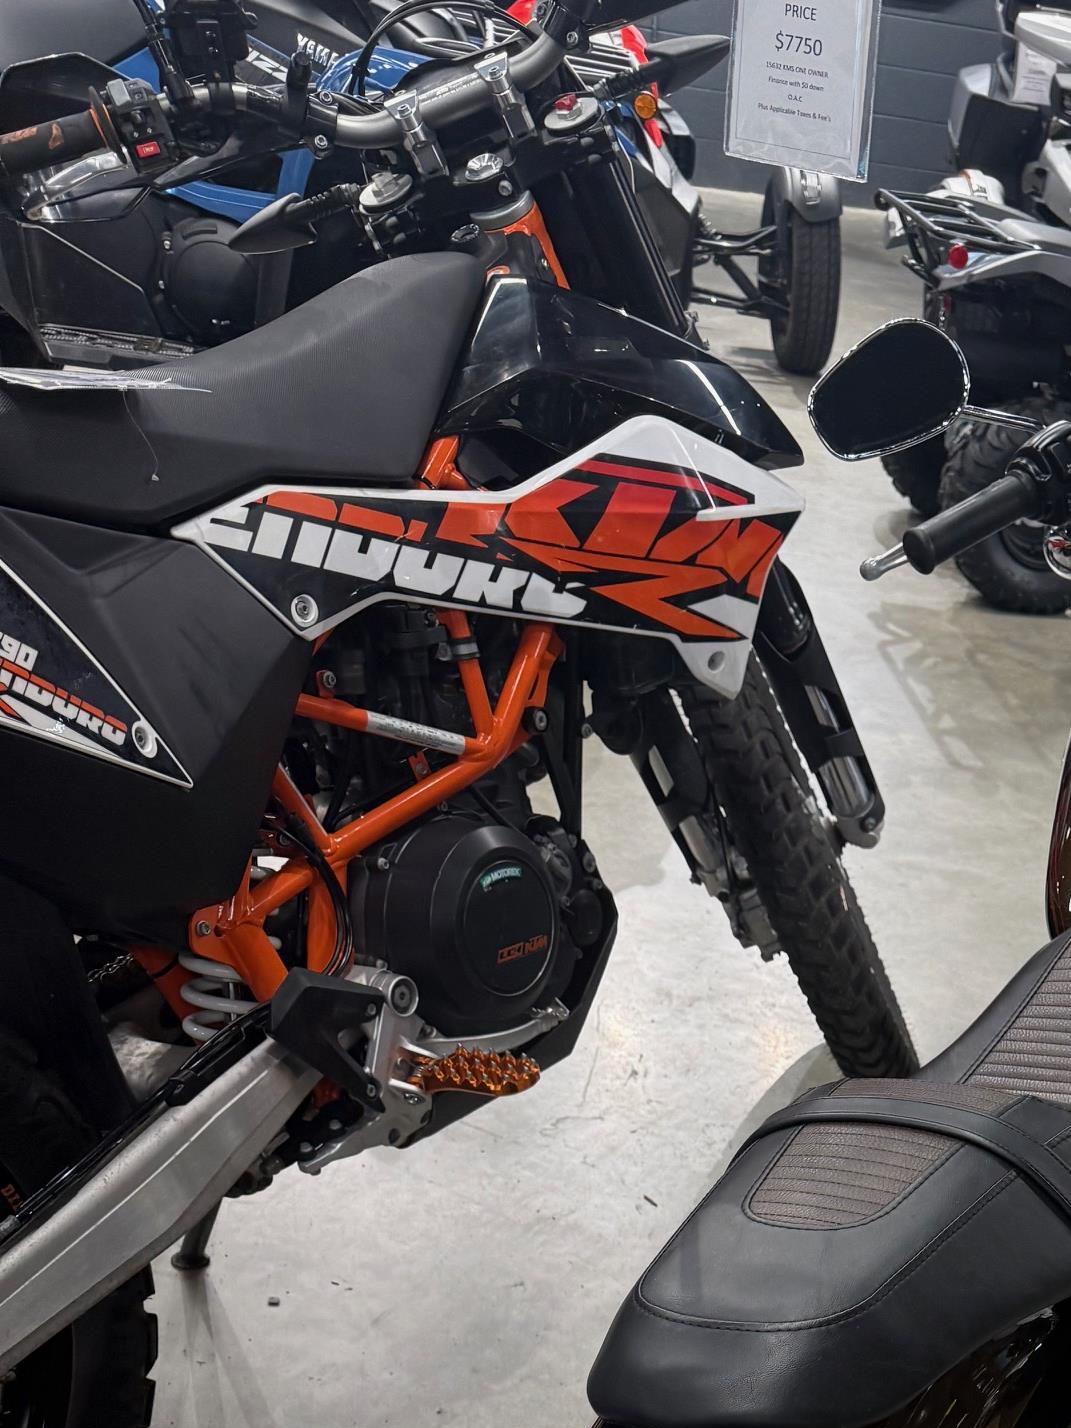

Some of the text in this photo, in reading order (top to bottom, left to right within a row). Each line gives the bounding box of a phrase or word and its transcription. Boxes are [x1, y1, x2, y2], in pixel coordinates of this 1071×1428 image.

[785, 3, 817, 21] PRICE
[775, 30, 823, 56] $7750
[766, 61, 782, 71] 15632
[783, 64, 795, 72] KMS
[807, 68, 830, 79] OWNER
[768, 75, 788, 86] Finance
[789, 80, 801, 88] with
[809, 84, 824, 92] down
[758, 102, 768, 111] Plus
[769, 104, 796, 115] Applicable
[797, 109, 812, 119] Taxes
[0, 630, 39, 672] 90
[0, 656, 128, 746] NDURO
[490, 867, 522, 882] MOTOREX
